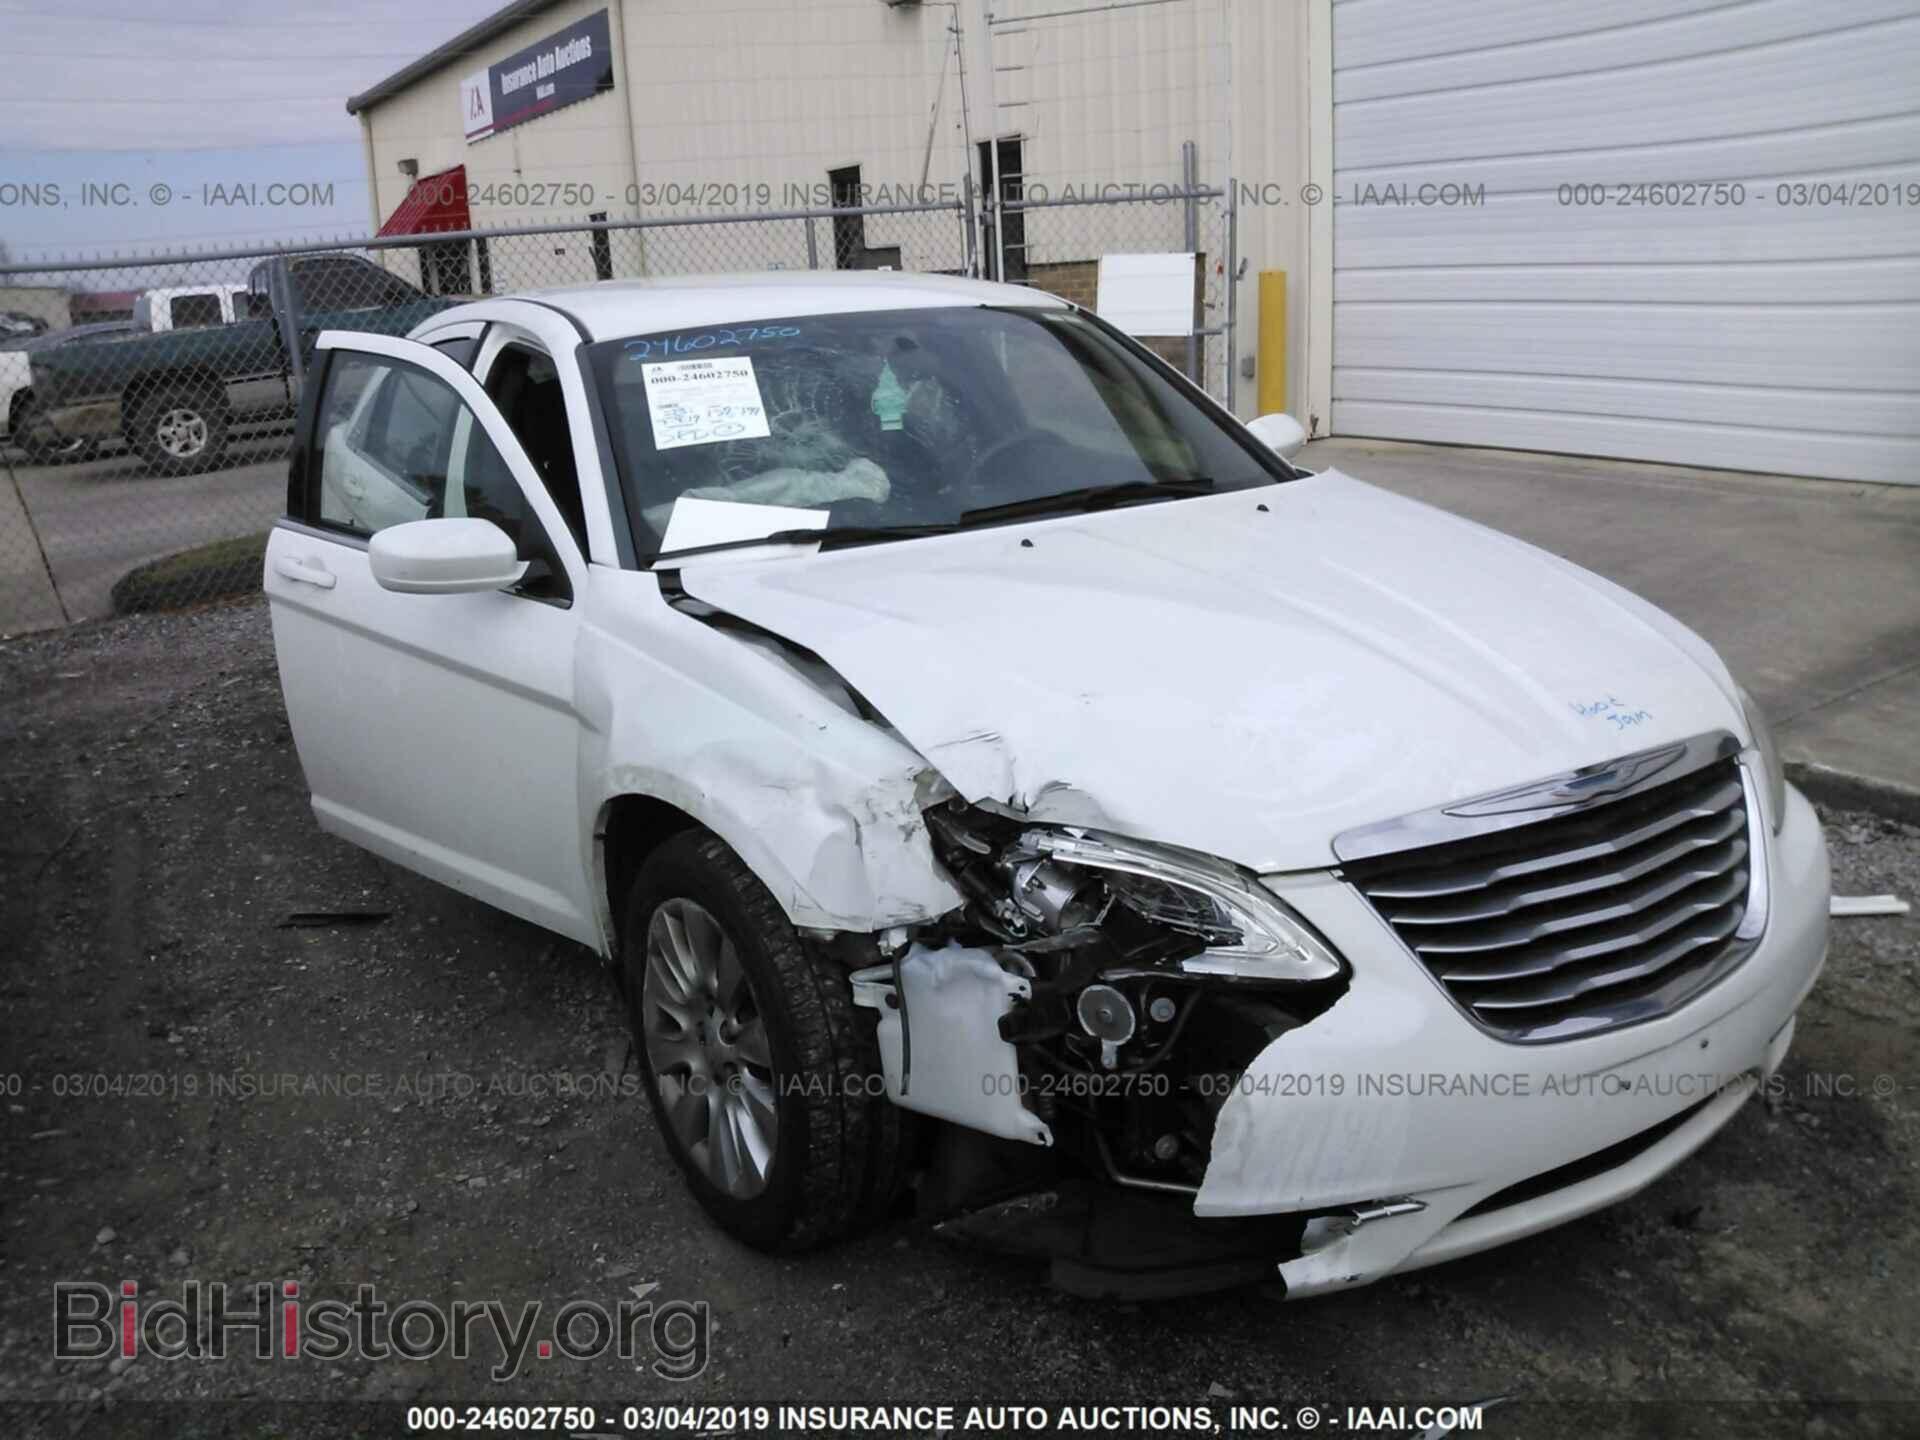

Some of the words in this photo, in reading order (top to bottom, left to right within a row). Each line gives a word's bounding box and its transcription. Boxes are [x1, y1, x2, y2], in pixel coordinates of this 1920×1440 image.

[501, 61, 537, 95] Insurance
[537, 52, 555, 79] Auto
[555, 35, 593, 71] Auctions
[650, 369, 749, 385] 000-24602750
